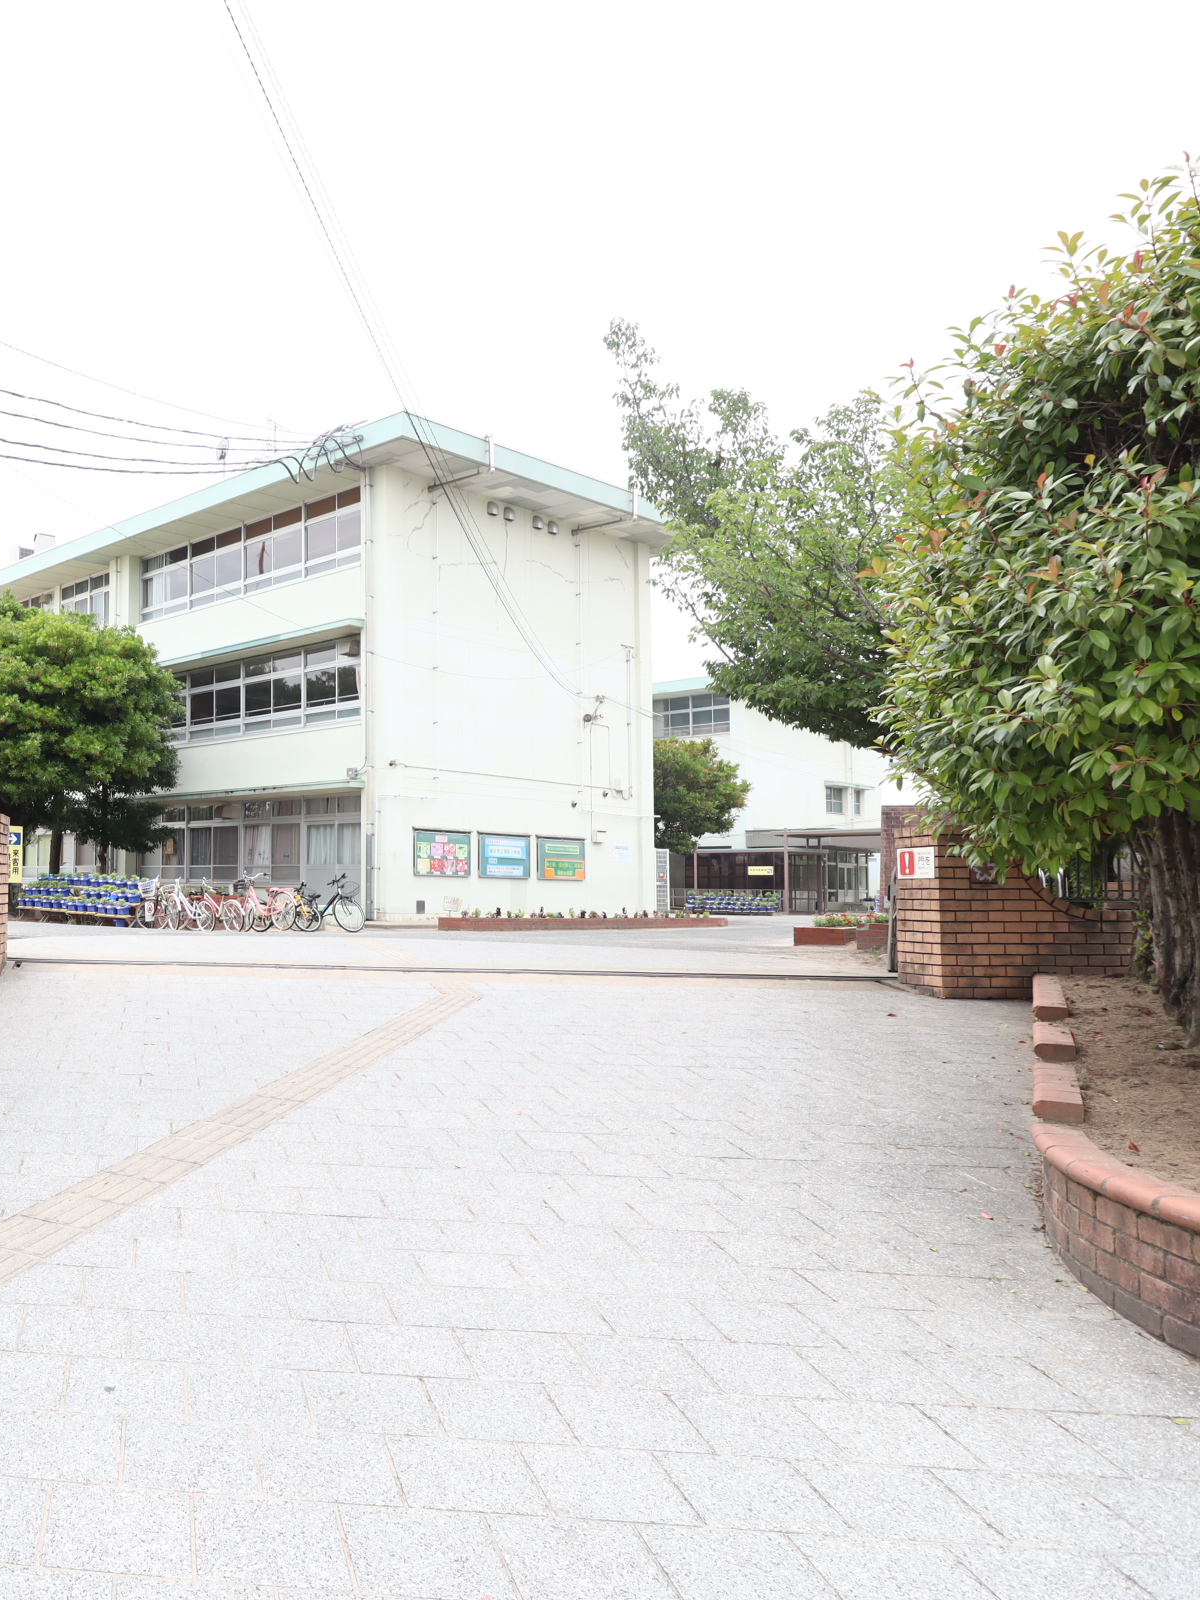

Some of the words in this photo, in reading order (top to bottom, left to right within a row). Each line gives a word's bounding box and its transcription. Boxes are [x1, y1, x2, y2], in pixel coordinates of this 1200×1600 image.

[12, 849, 20, 875] 来客用
[918, 855, 931, 866] 門を
